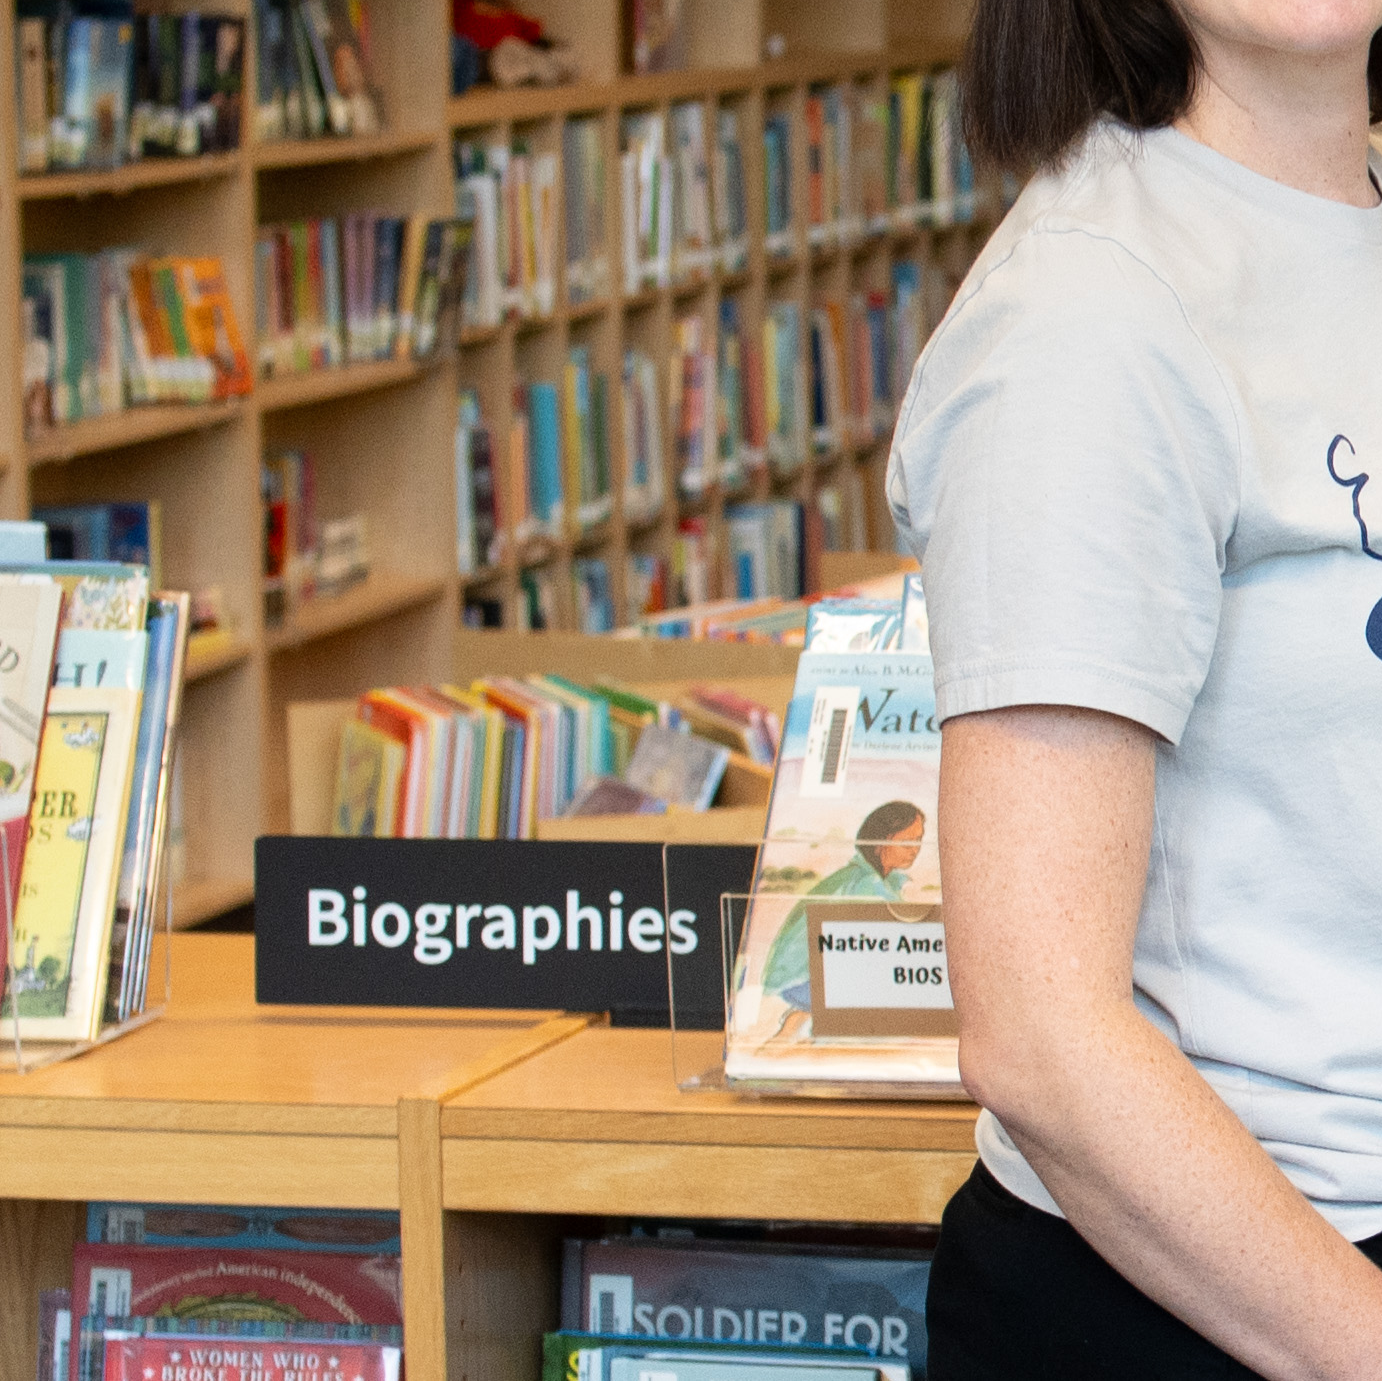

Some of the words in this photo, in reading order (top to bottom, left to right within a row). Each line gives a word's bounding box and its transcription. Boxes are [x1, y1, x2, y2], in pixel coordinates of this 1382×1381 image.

[306, 885, 699, 966] Biographies
[818, 933, 890, 953] Native
[893, 966, 943, 986] BIOS
[823, 1312, 910, 1357] FOR
[189, 1349, 264, 1368] WOMEN
[272, 1352, 320, 1369] WHO
